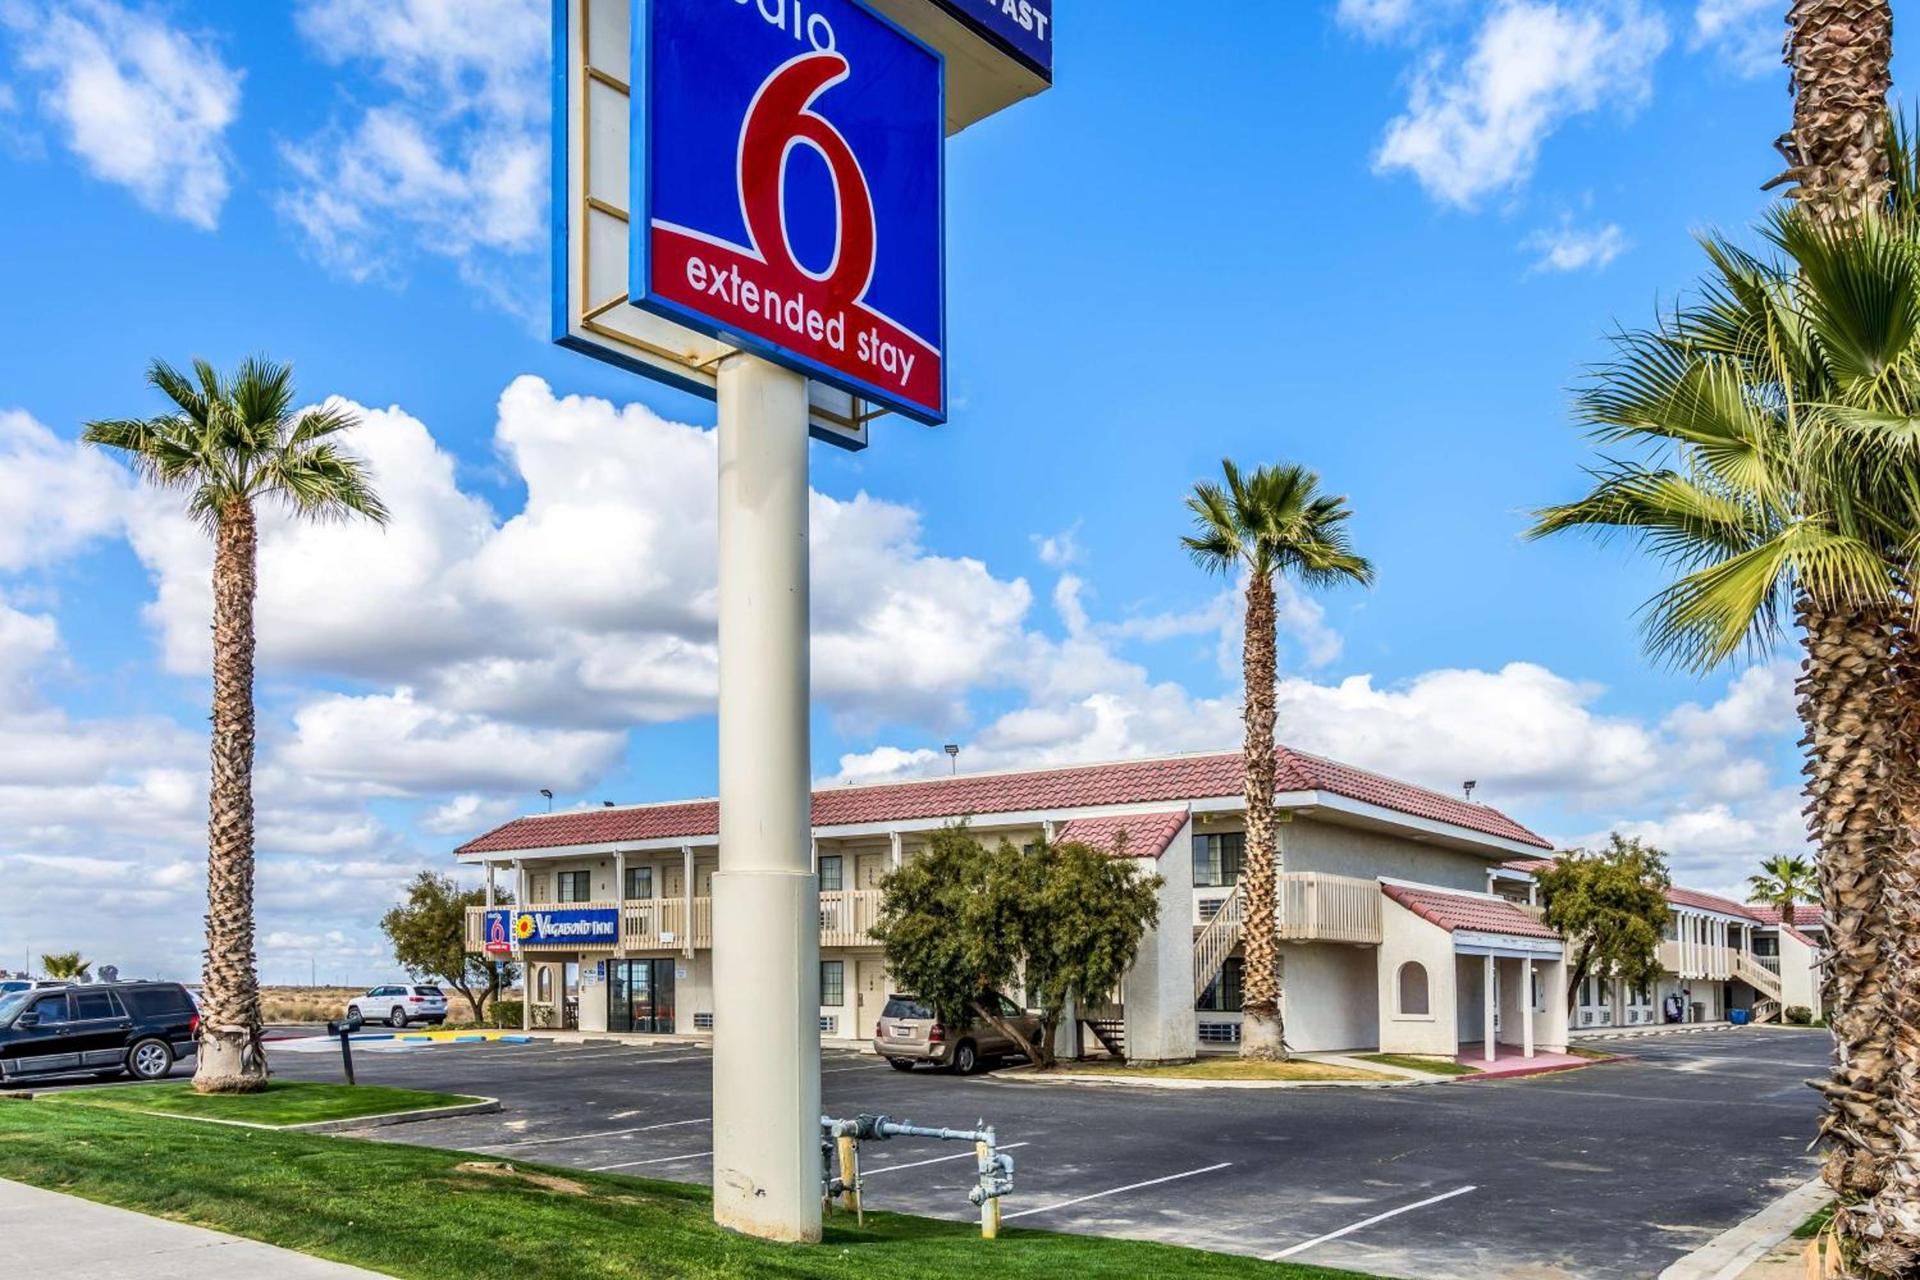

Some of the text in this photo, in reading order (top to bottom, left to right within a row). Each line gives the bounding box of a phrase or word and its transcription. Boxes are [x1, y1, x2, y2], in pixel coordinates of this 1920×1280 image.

[734, 0, 836, 53] dio
[988, 0, 1048, 40] AST
[737, 51, 877, 303] 6
[686, 256, 915, 387] extended stay
